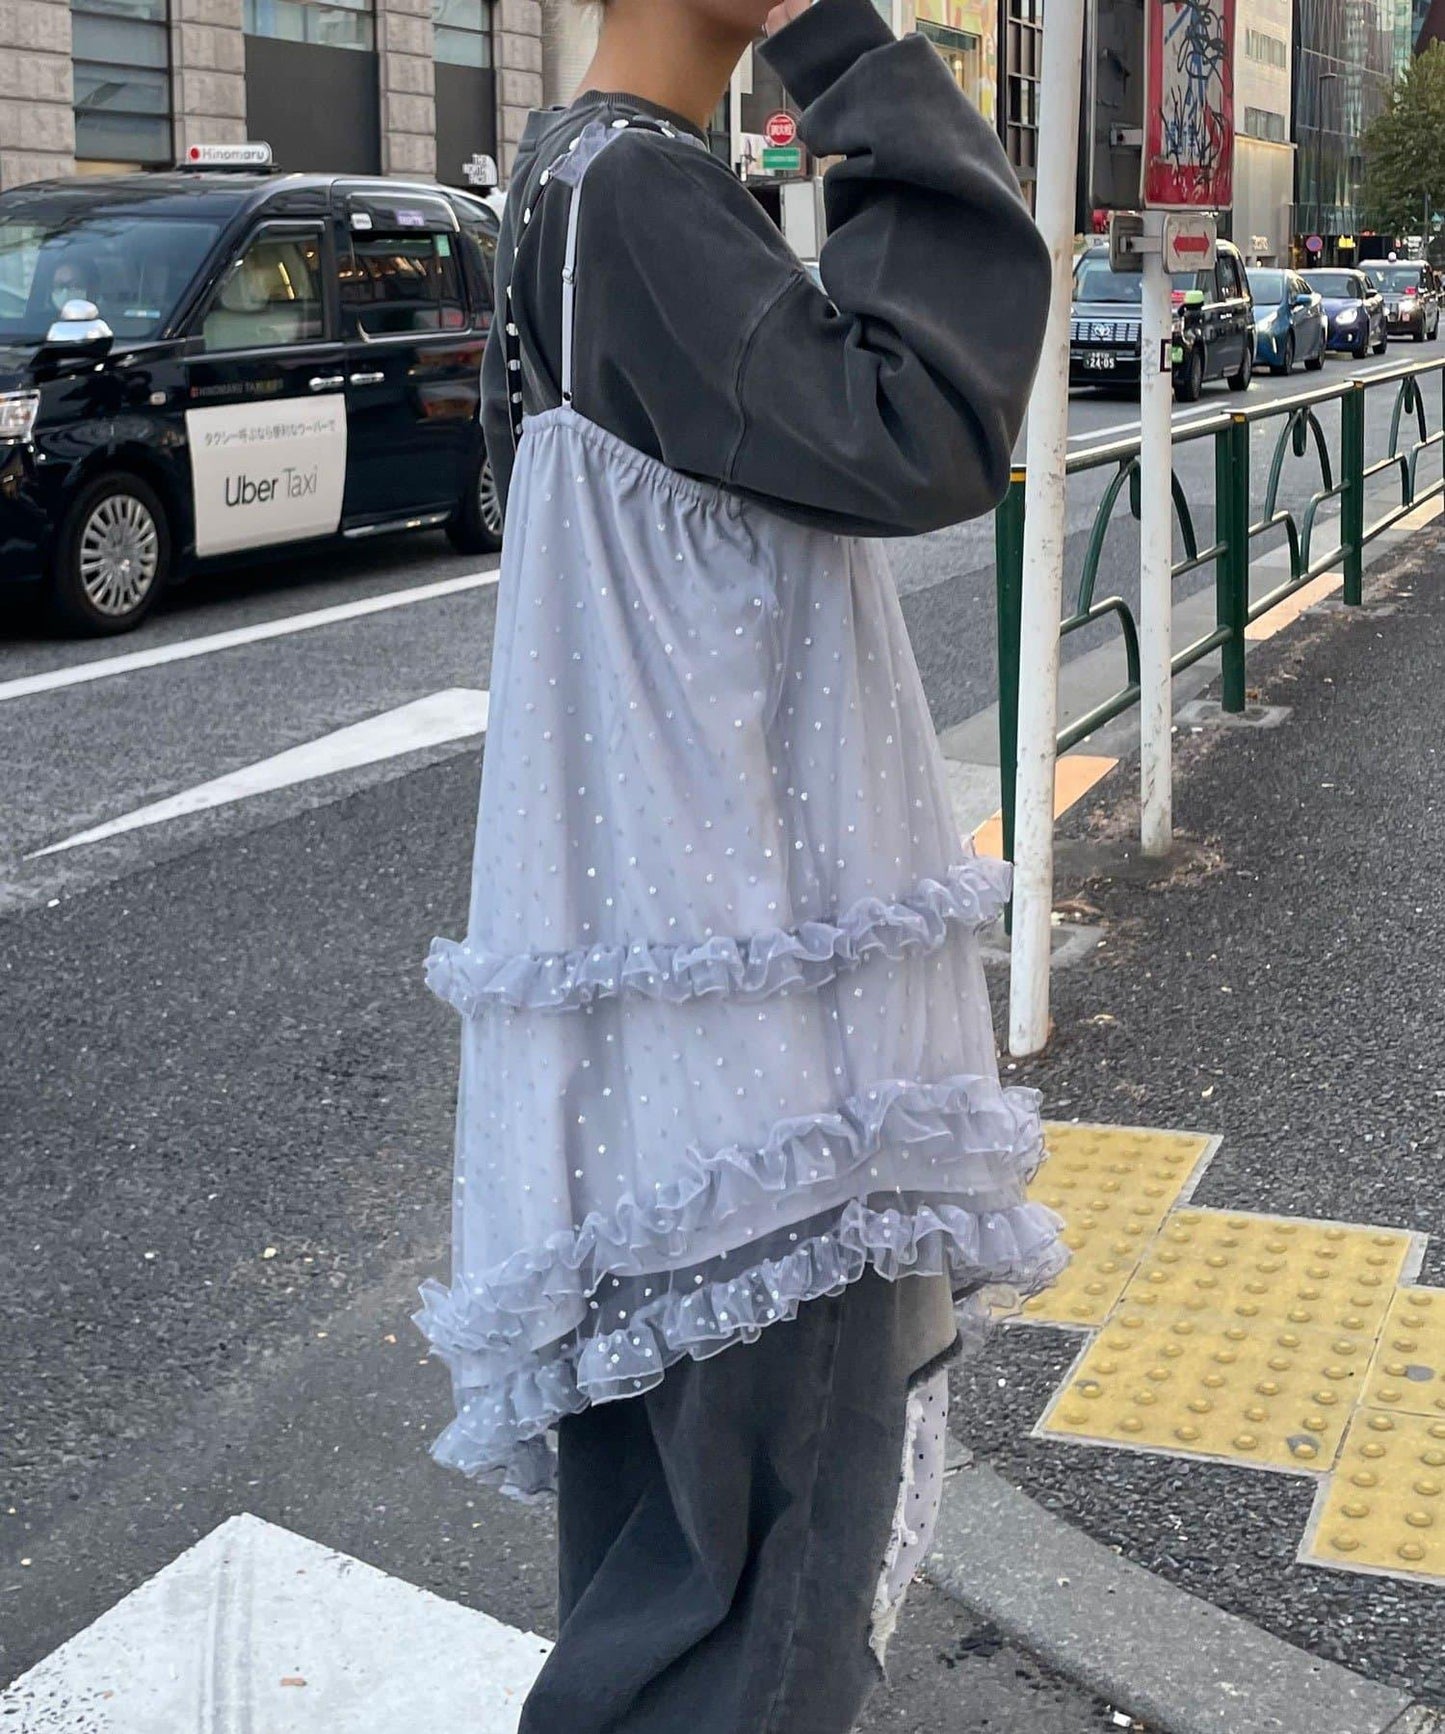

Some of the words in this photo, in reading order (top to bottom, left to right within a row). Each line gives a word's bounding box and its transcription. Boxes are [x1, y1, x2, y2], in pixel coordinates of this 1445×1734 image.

[202, 147, 265, 160] Hinomaru
[225, 475, 279, 507] Uber
[282, 464, 318, 498] Taxi
